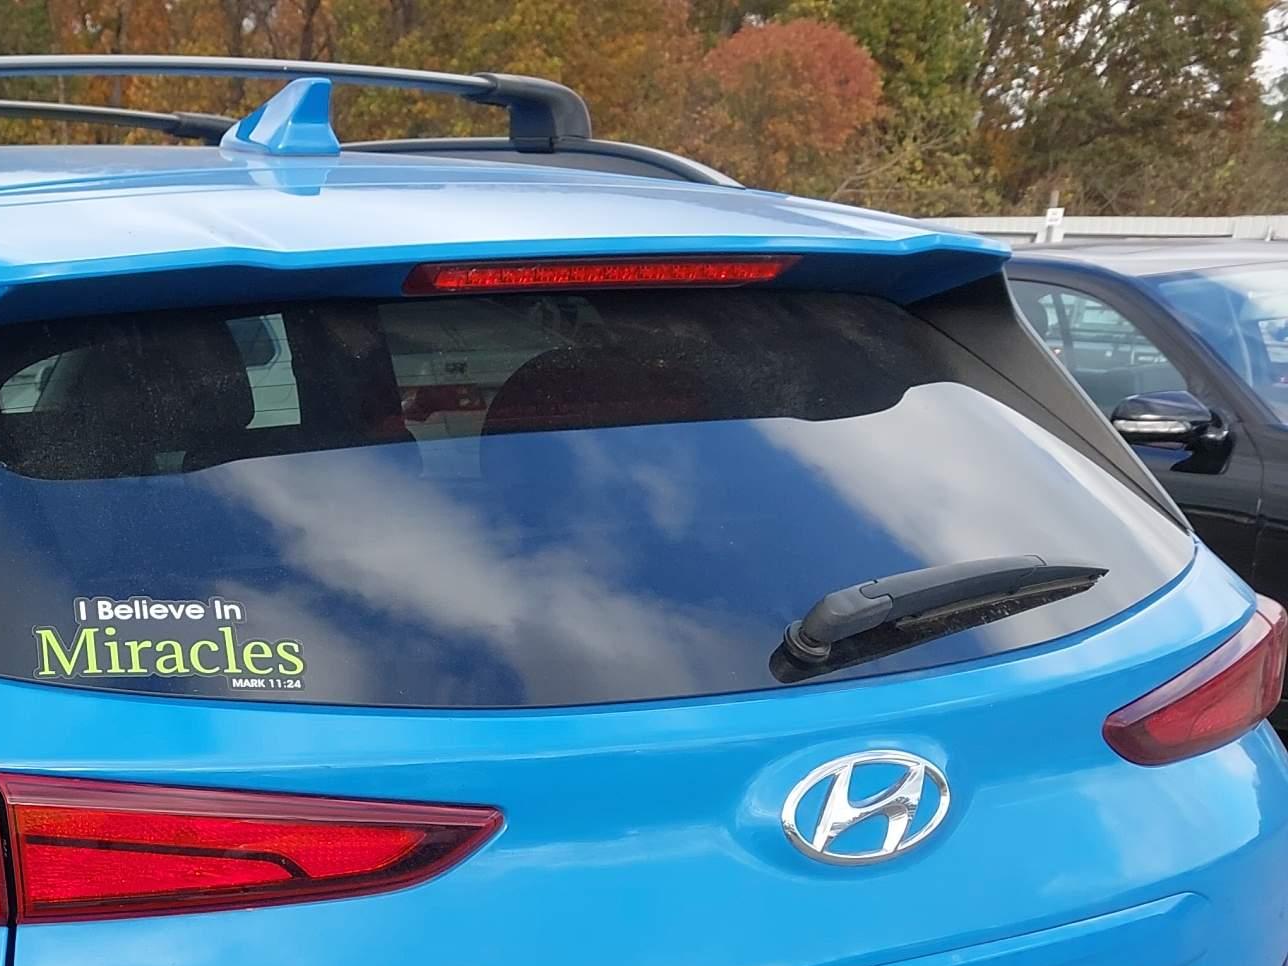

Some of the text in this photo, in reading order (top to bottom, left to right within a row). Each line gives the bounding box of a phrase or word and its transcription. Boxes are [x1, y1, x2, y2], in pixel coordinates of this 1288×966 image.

[79, 600, 242, 620] I Believe In
[36, 626, 304, 675] Miracles
[232, 678, 302, 689] MARK 11:24
